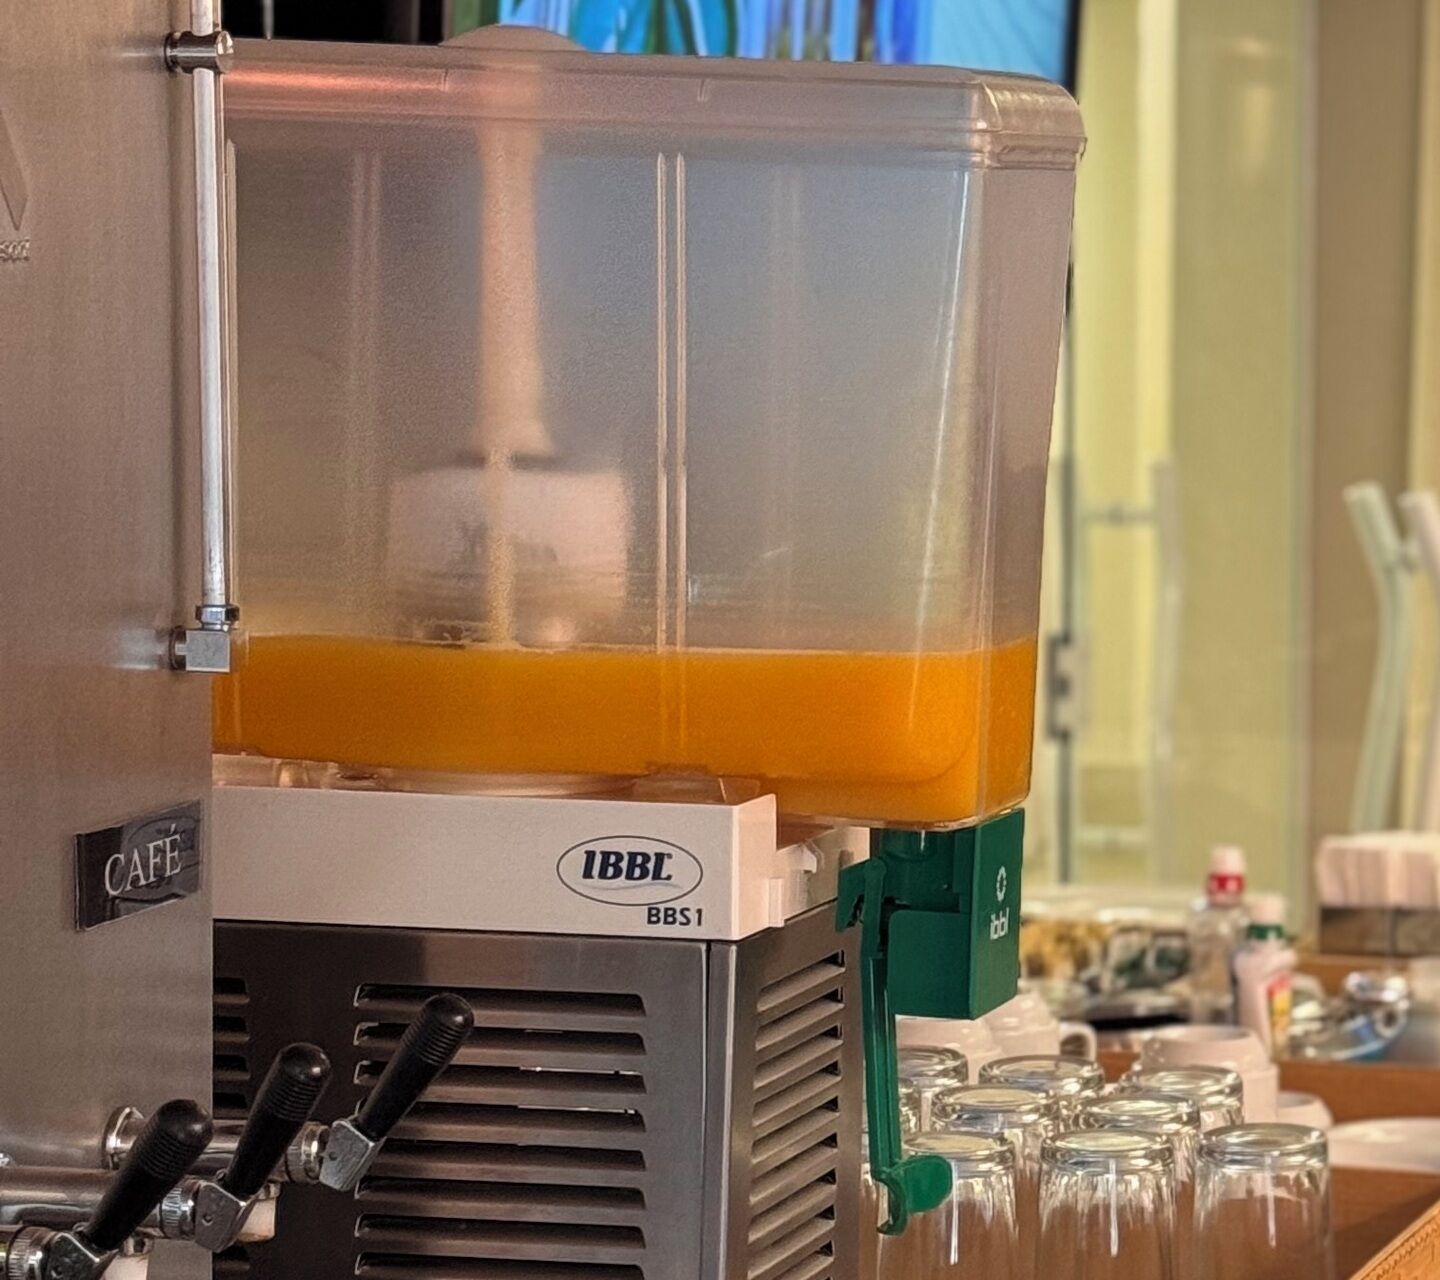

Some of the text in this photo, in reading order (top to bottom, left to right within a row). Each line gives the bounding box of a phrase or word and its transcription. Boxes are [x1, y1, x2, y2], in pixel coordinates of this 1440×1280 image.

[104, 823, 181, 896] CAFÉ
[582, 850, 673, 881] IBBL
[990, 907, 1009, 940] ibbl
